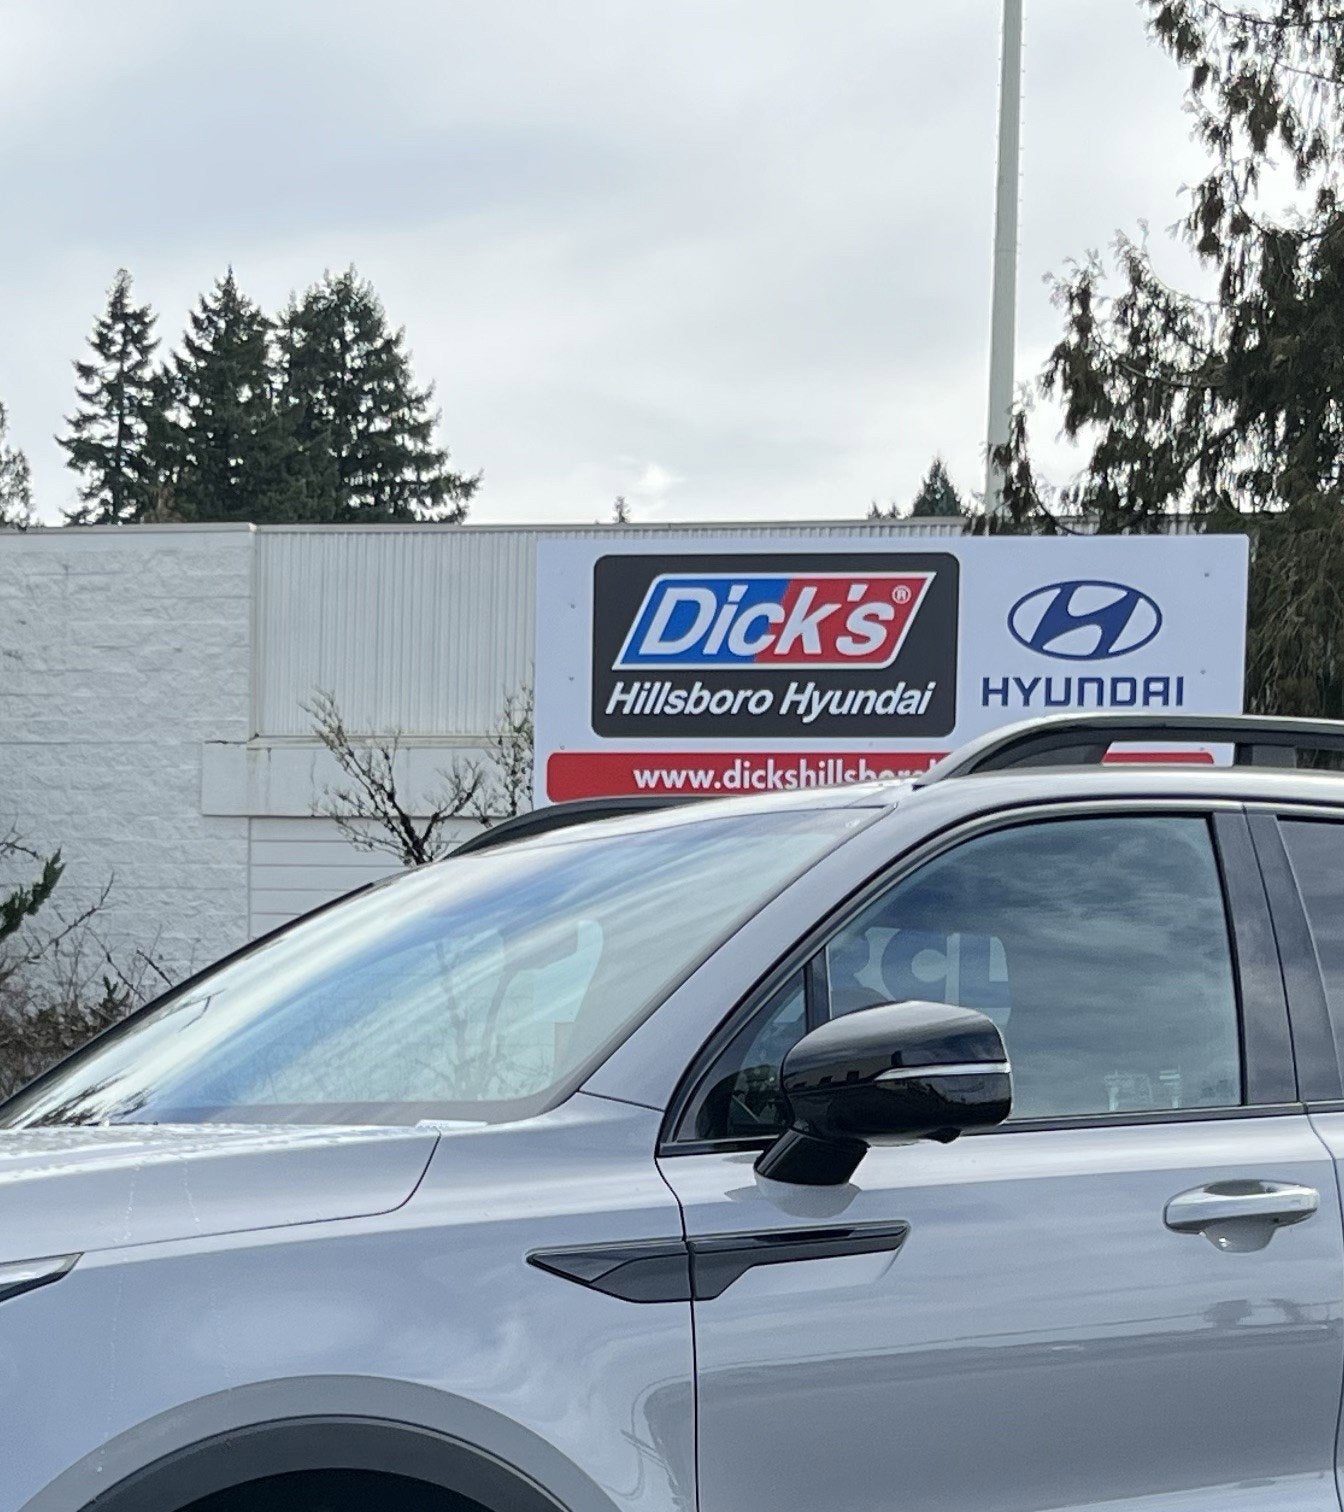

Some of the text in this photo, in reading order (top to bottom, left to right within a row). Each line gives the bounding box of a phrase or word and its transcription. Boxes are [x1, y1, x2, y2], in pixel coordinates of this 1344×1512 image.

[638, 584, 896, 657] Dick's
[605, 681, 937, 723] Hillsboro Hyundai
[982, 676, 1184, 707] HYUNDAI
